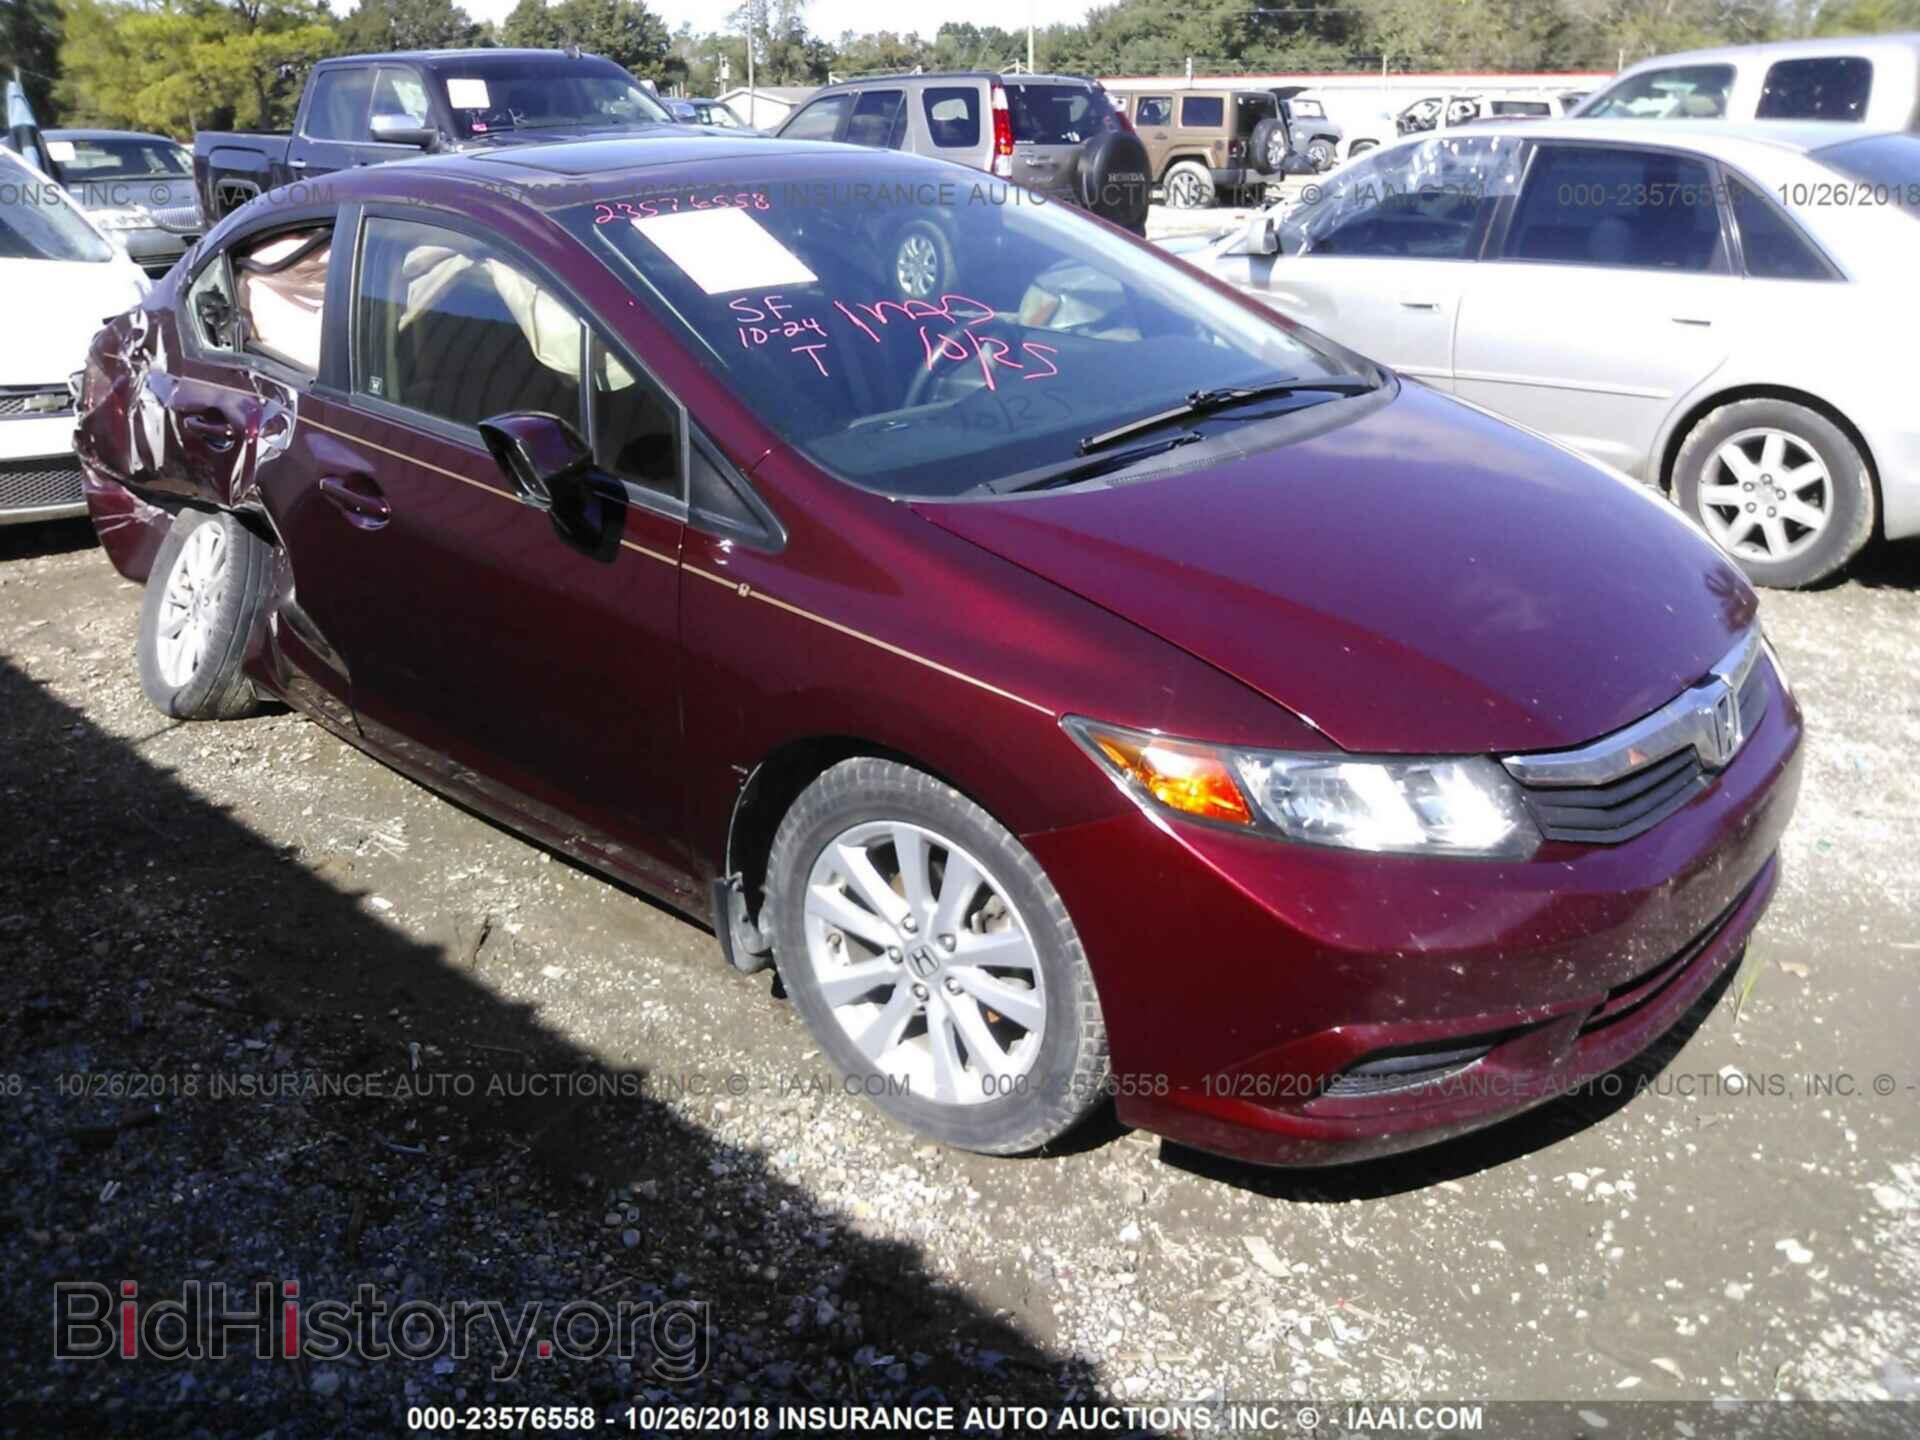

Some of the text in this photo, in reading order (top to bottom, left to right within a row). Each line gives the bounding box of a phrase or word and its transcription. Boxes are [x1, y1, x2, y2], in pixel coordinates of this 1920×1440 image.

[729, 296, 792, 322] SF
[738, 318, 828, 348] 10-24
[790, 343, 829, 377] T
